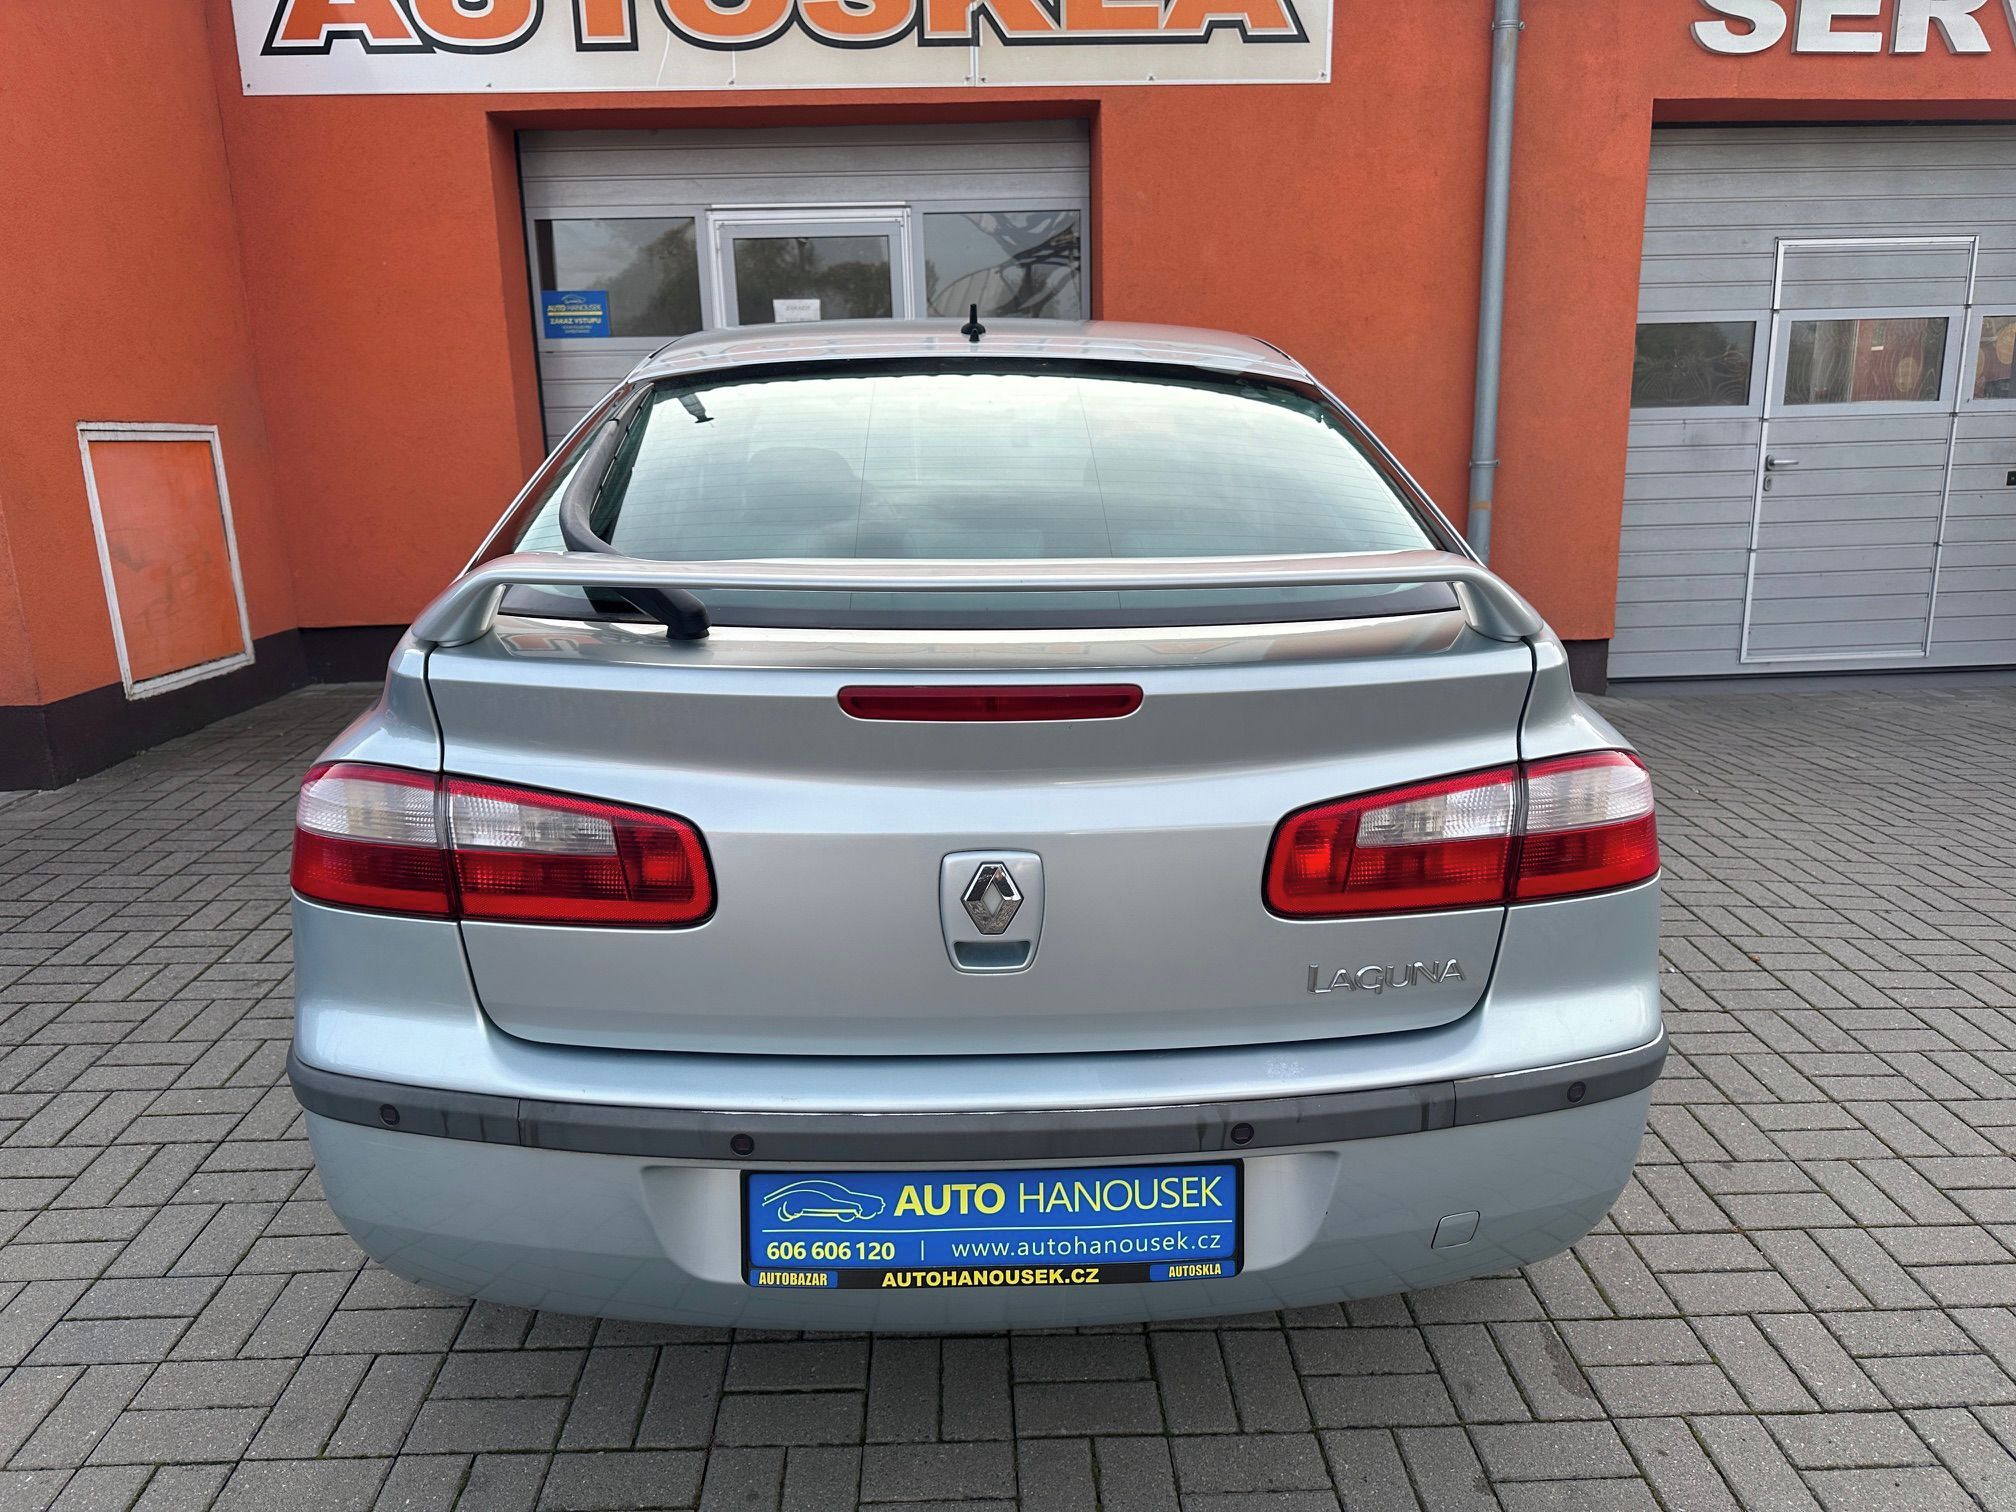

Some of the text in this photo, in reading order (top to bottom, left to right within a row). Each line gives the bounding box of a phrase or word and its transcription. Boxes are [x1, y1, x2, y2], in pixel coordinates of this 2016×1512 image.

[1690, 0, 2016, 55] SER
[1307, 958, 1465, 994] LAGUNA
[894, 1176, 1223, 1217] AUTO HANOUSEK
[766, 1231, 1221, 1260] 606 606 120 www.autohanousek.cz
[758, 1271, 828, 1286] AUTOBAZAR
[882, 1268, 1100, 1288] AUTOHANOUSEK.CZ
[1168, 1263, 1222, 1278] AUTOSKLA
